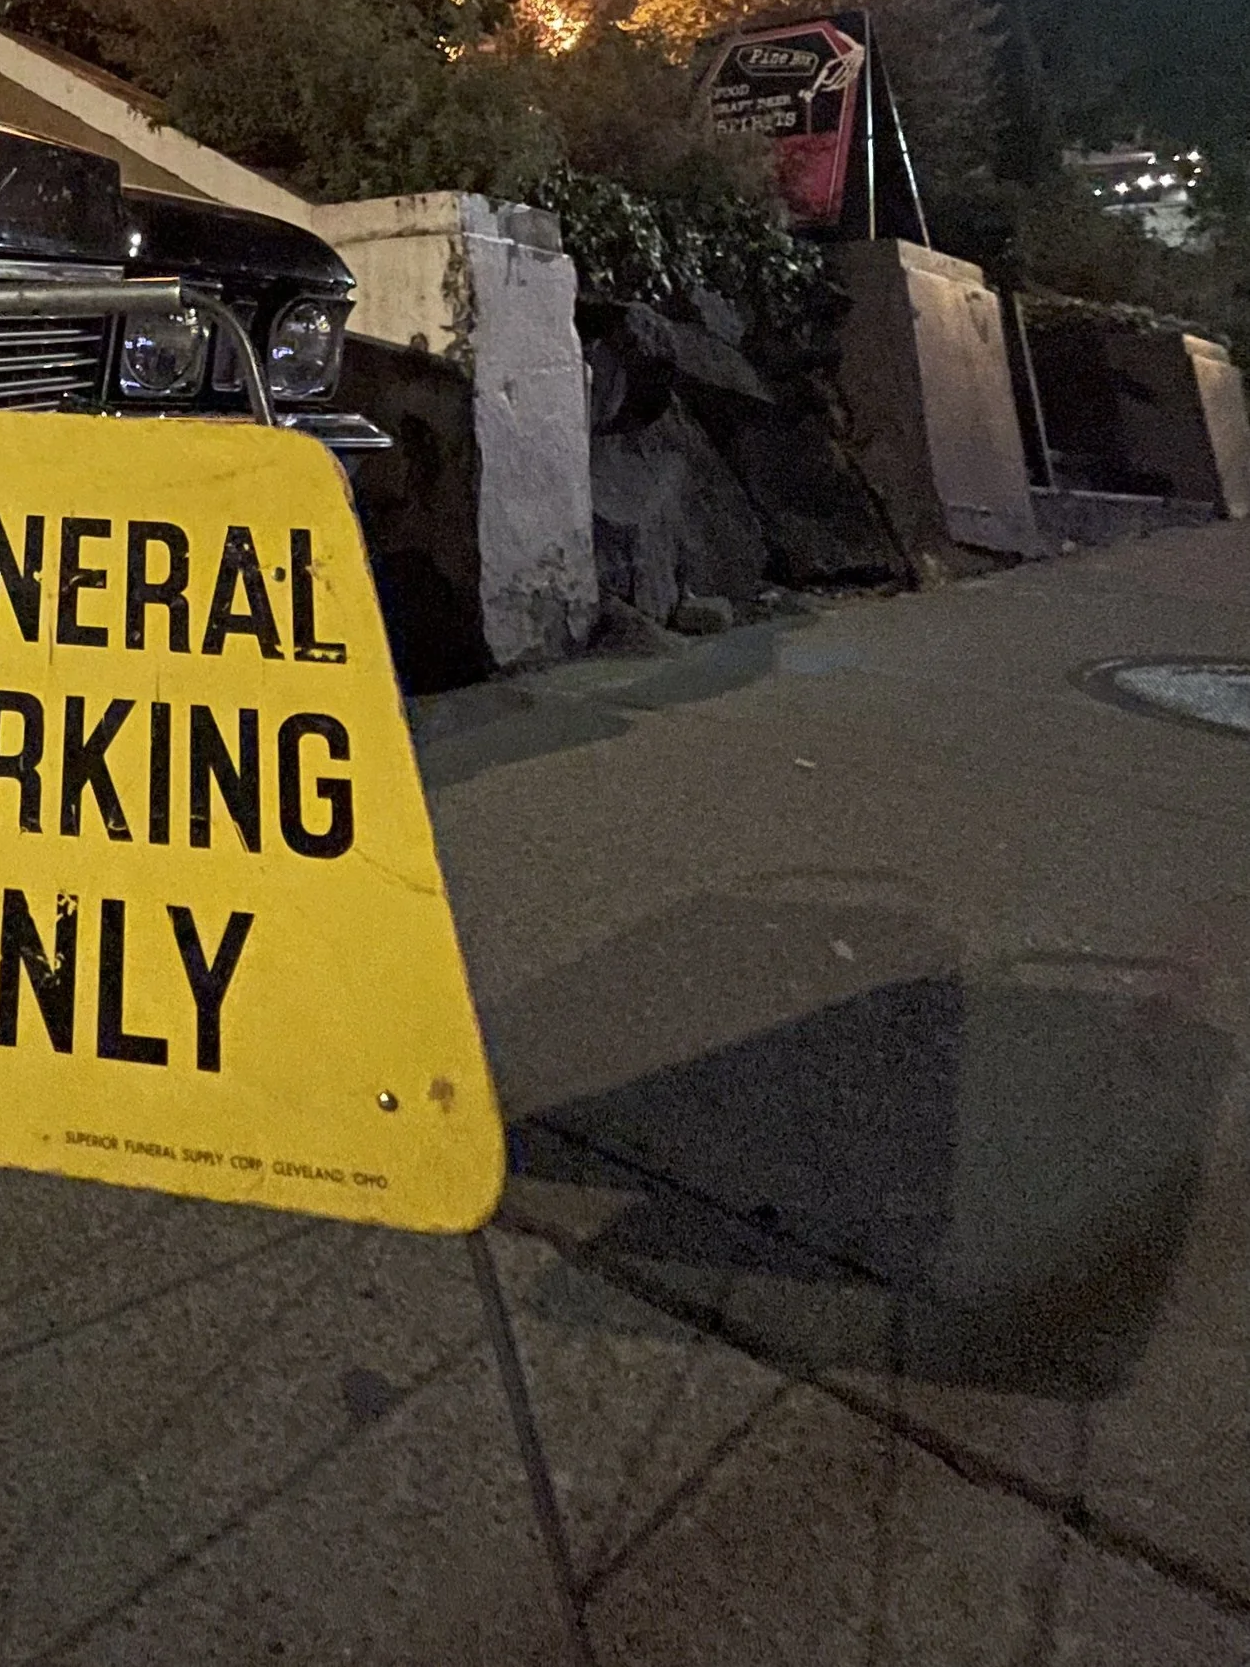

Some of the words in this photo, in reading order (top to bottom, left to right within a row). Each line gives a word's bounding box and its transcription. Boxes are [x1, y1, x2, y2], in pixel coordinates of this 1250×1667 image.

[749, 48, 789, 65] Pine
[65, 1131, 118, 1150] SUPERIOR
[124, 1139, 177, 1160] FUNERAL
[181, 1148, 224, 1166] SUPPLY
[352, 1171, 389, 1190] OHIO
